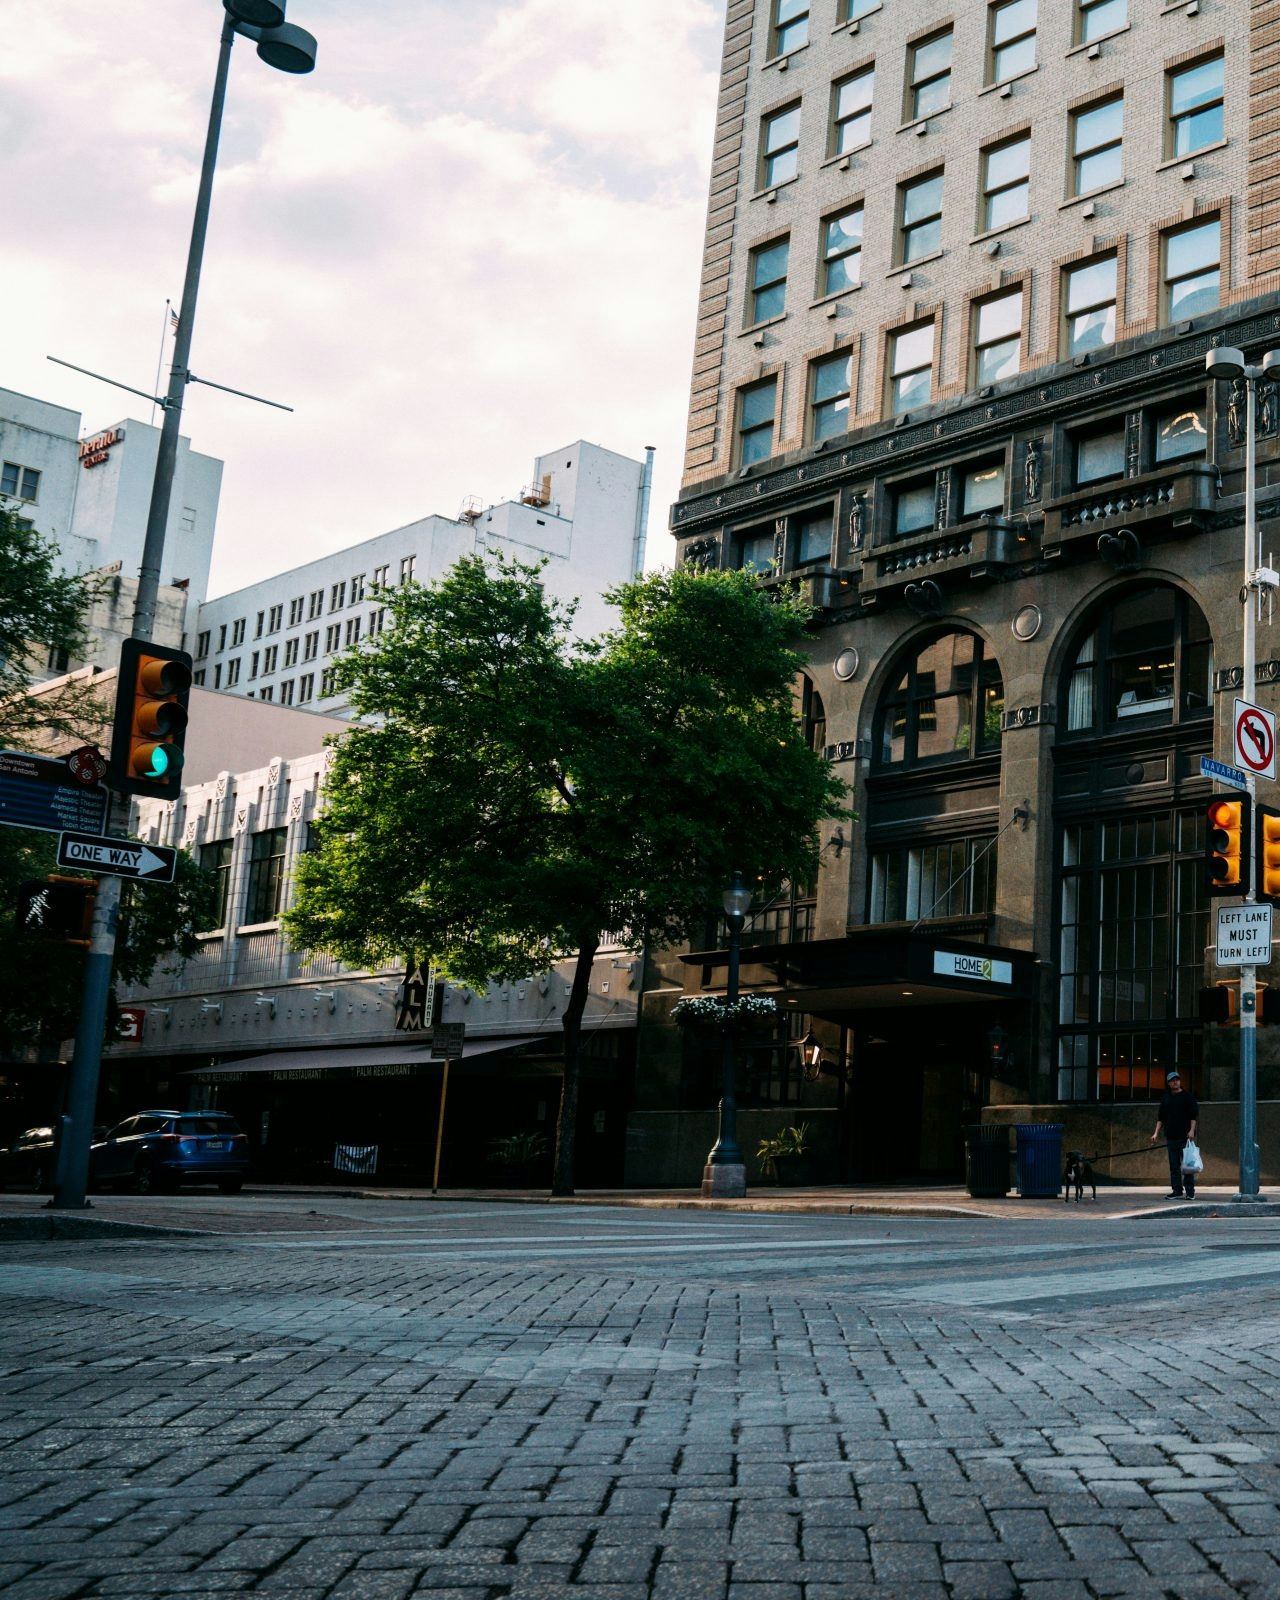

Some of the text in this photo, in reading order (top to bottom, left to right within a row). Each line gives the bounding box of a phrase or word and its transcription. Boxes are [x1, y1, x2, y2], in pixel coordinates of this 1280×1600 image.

[0, 756, 36, 769] Downtown
[12, 766, 39, 777] Antonio
[1204, 759, 1242, 781] NAVARRO
[57, 811, 79, 820] Market
[79, 823, 101, 832] Center
[70, 844, 142, 866] ONE WAY
[1220, 912, 1268, 924] LEFT LANE
[1229, 929, 1258, 942] MUST
[1219, 946, 1268, 958] TURN LEFT
[402, 960, 424, 1029] ALM
[273, 1069, 322, 1080] PALM RESTAURANT
[356, 1064, 411, 1077] PALM RESTAURANT
